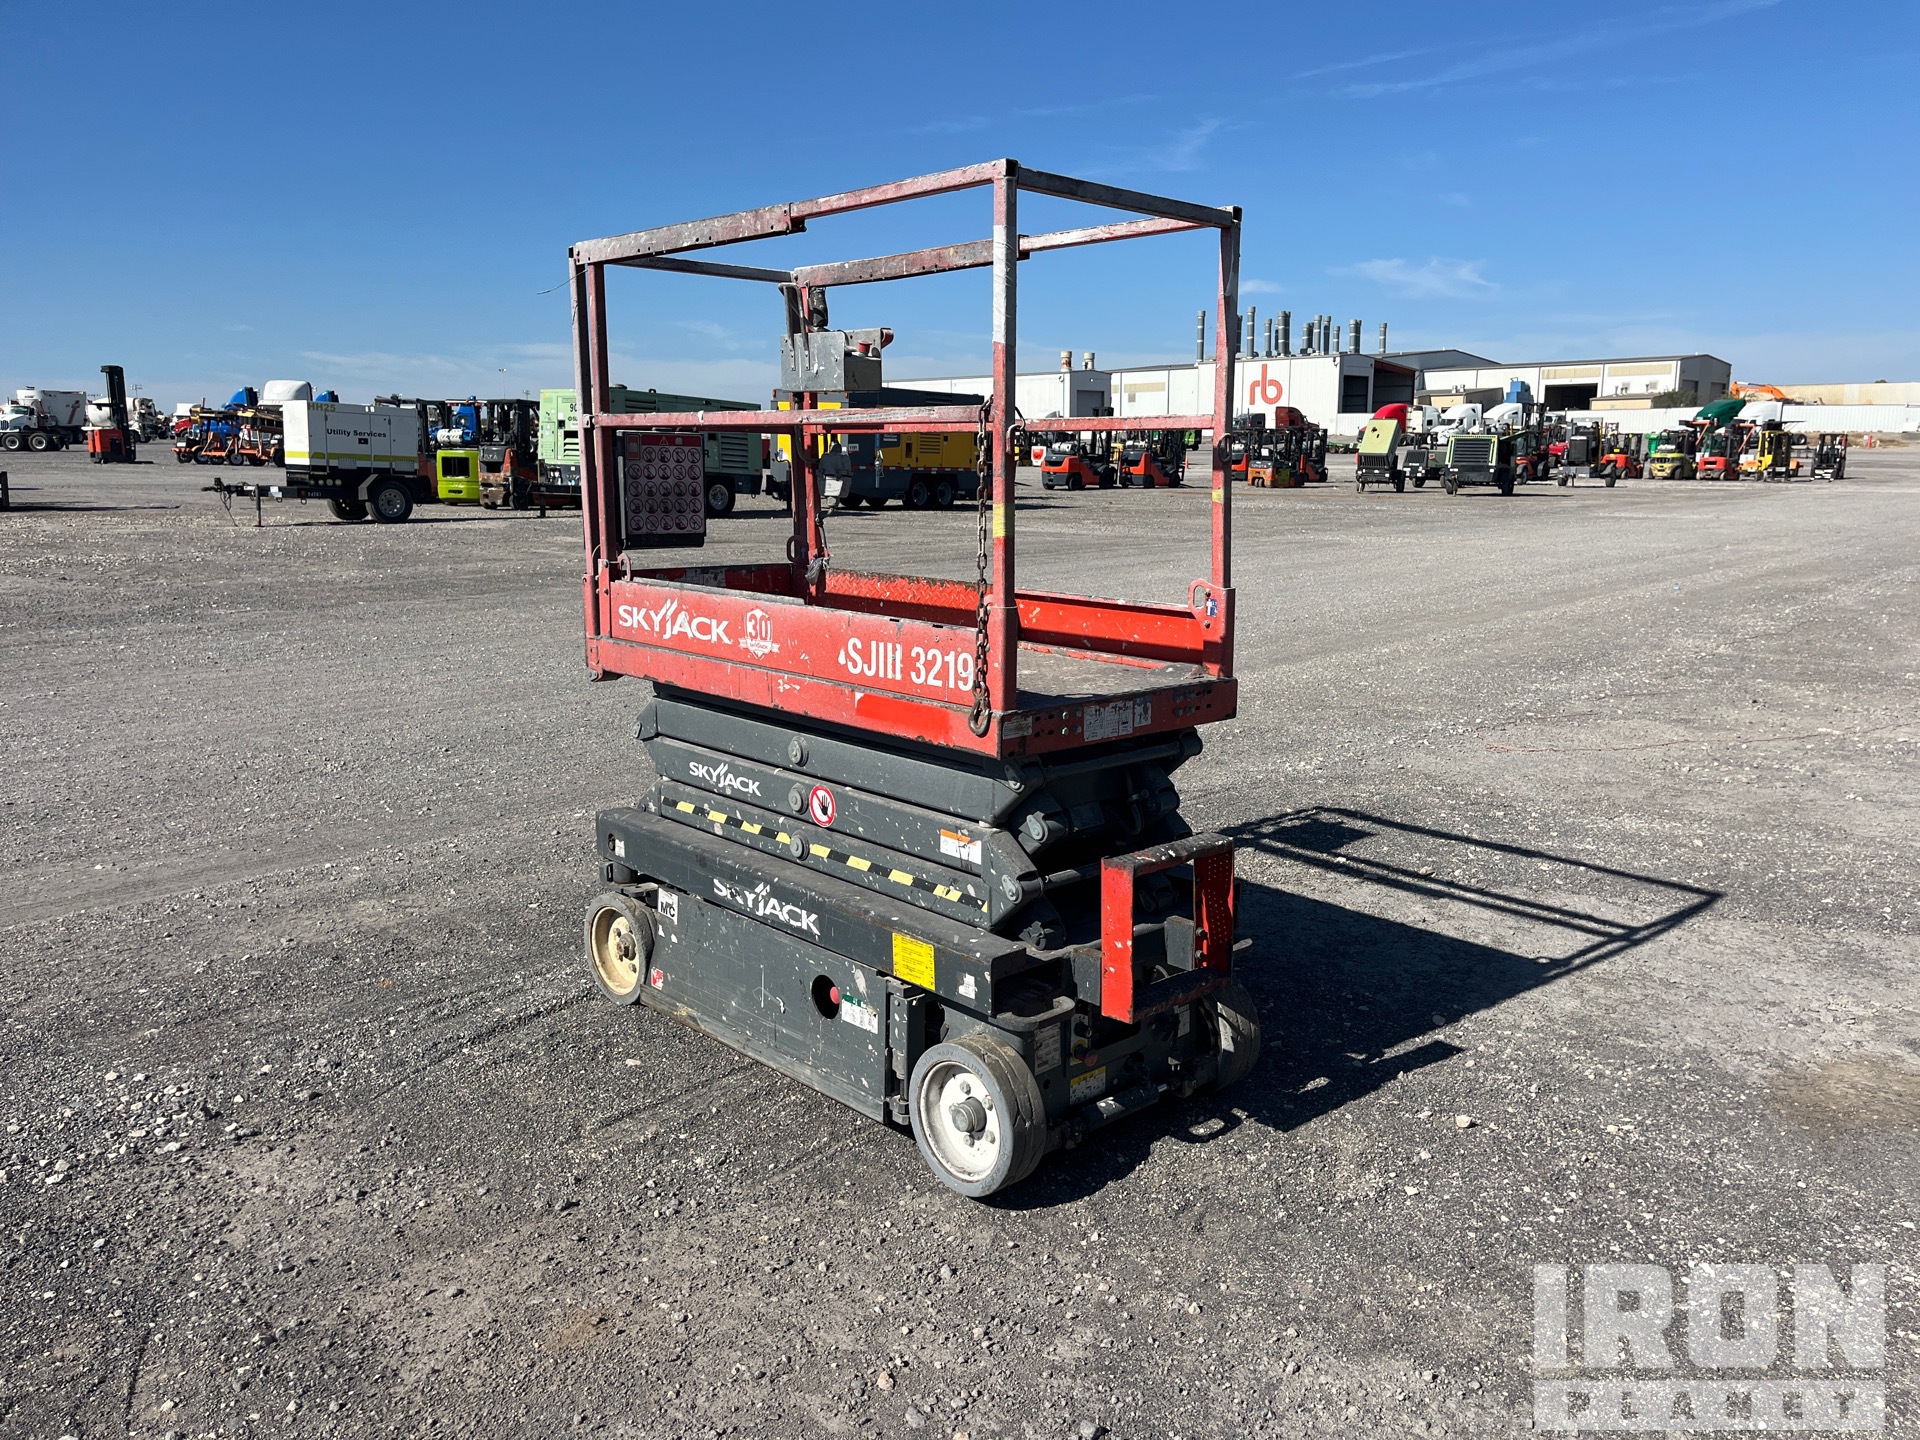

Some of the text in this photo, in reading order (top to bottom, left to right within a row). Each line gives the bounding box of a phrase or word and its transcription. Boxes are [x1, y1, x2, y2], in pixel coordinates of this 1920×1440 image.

[1249, 363, 1283, 405] rb
[308, 402, 336, 412] HH25
[326, 428, 387, 438] Utility Services
[618, 598, 733, 645] SKYJACK
[748, 612, 771, 641] 30
[910, 646, 975, 692] 3219
[689, 762, 761, 797] SKYJACK
[660, 901, 675, 918] MC
[713, 878, 821, 936] SKYJACK
